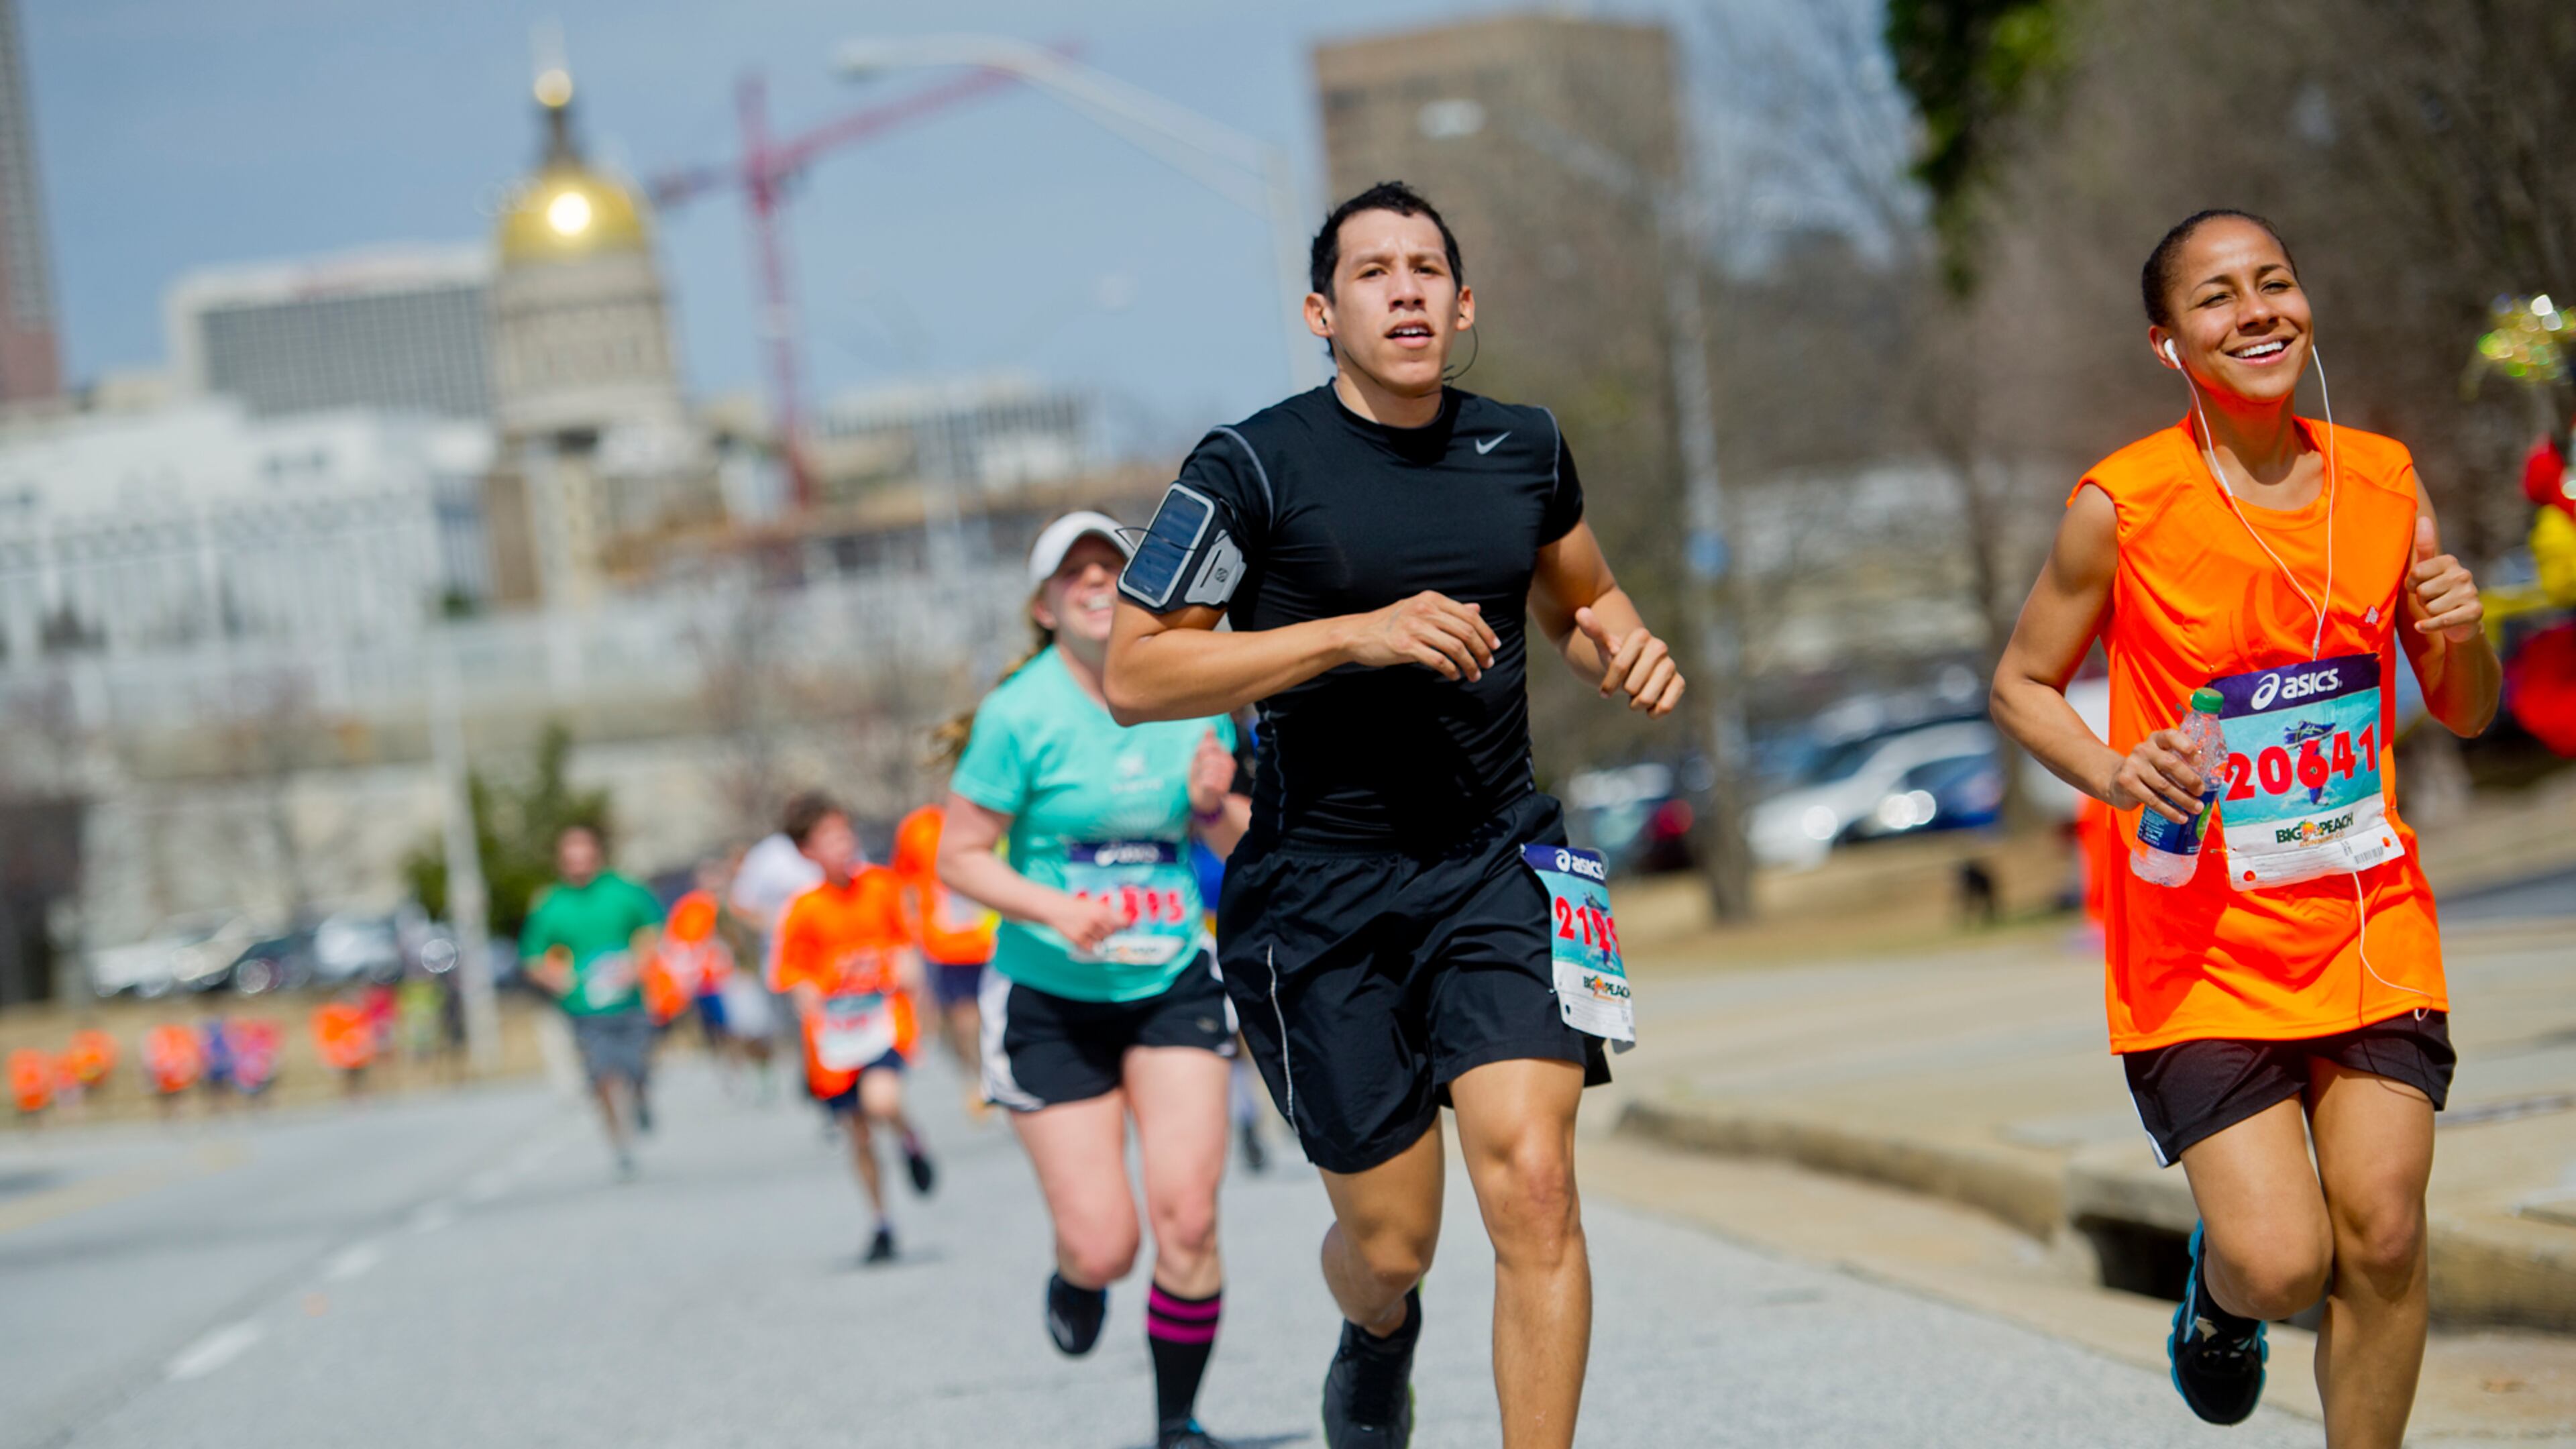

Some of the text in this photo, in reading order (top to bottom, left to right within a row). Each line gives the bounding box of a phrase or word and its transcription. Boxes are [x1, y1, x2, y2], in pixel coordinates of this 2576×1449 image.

[2282, 669, 2339, 698] asics
[2224, 723, 2376, 801] 20641
[2275, 812, 2354, 843] BIG PEACH
[1572, 857, 1605, 880] asics
